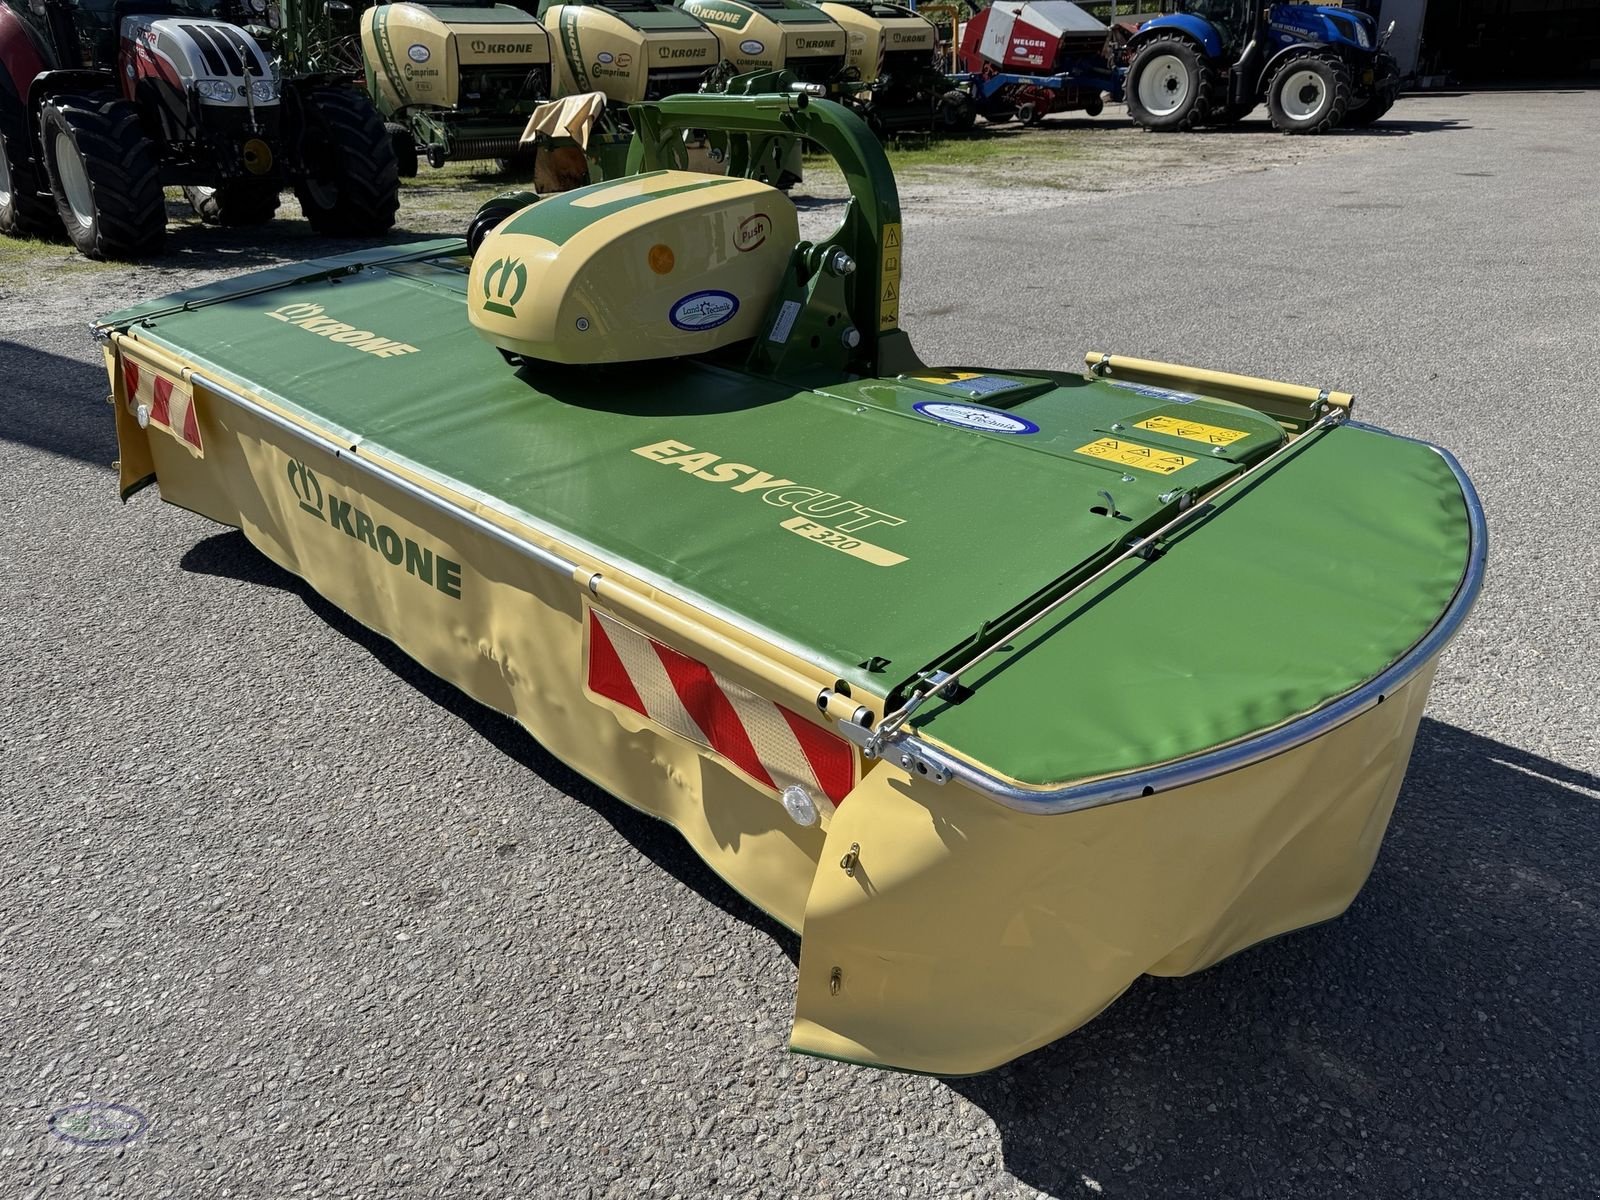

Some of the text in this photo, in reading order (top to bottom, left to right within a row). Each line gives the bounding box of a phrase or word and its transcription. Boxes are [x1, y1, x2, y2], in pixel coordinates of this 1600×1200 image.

[700, 8, 741, 24] KRONE
[1284, 24, 1308, 35] HOLLAND
[806, 40, 836, 49] KRONE
[901, 34, 927, 43] KRONE
[1013, 38, 1046, 47] WELGER
[488, 44, 533, 53] KRONE
[671, 48, 707, 58] KRONE
[736, 58, 772, 67] COMPRIMA
[404, 63, 439, 81] Comprima
[592, 62, 630, 78] Comprima
[682, 302, 731, 316] Land Technik
[289, 315, 421, 358] KRONE
[974, 415, 1017, 430] Technik
[792, 522, 862, 550] F 320
[329, 494, 461, 600] KRONE
